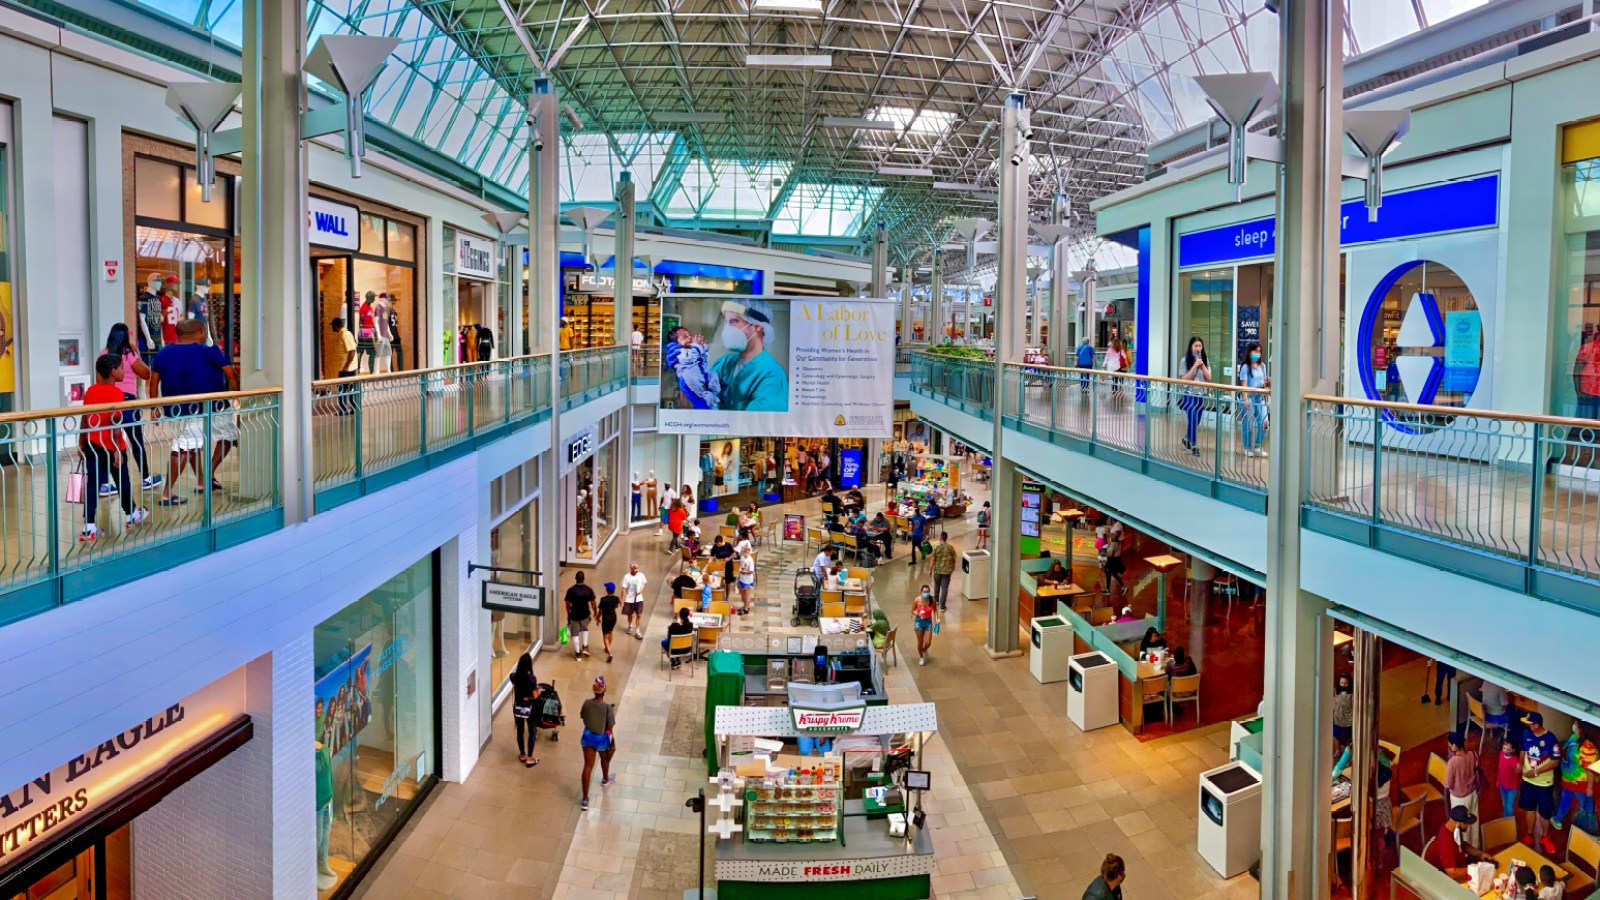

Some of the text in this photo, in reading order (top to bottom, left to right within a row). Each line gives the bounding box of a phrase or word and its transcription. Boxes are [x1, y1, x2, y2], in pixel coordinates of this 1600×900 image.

[315, 211, 348, 236] WALL
[1235, 229, 1268, 248] sleep
[797, 303, 869, 320] A Labor
[822, 324, 887, 341] of Love
[808, 355, 838, 363] Community
[799, 712, 860, 727] Krispy Kreme
[759, 863, 889, 876] MADE FRESH DAILY
